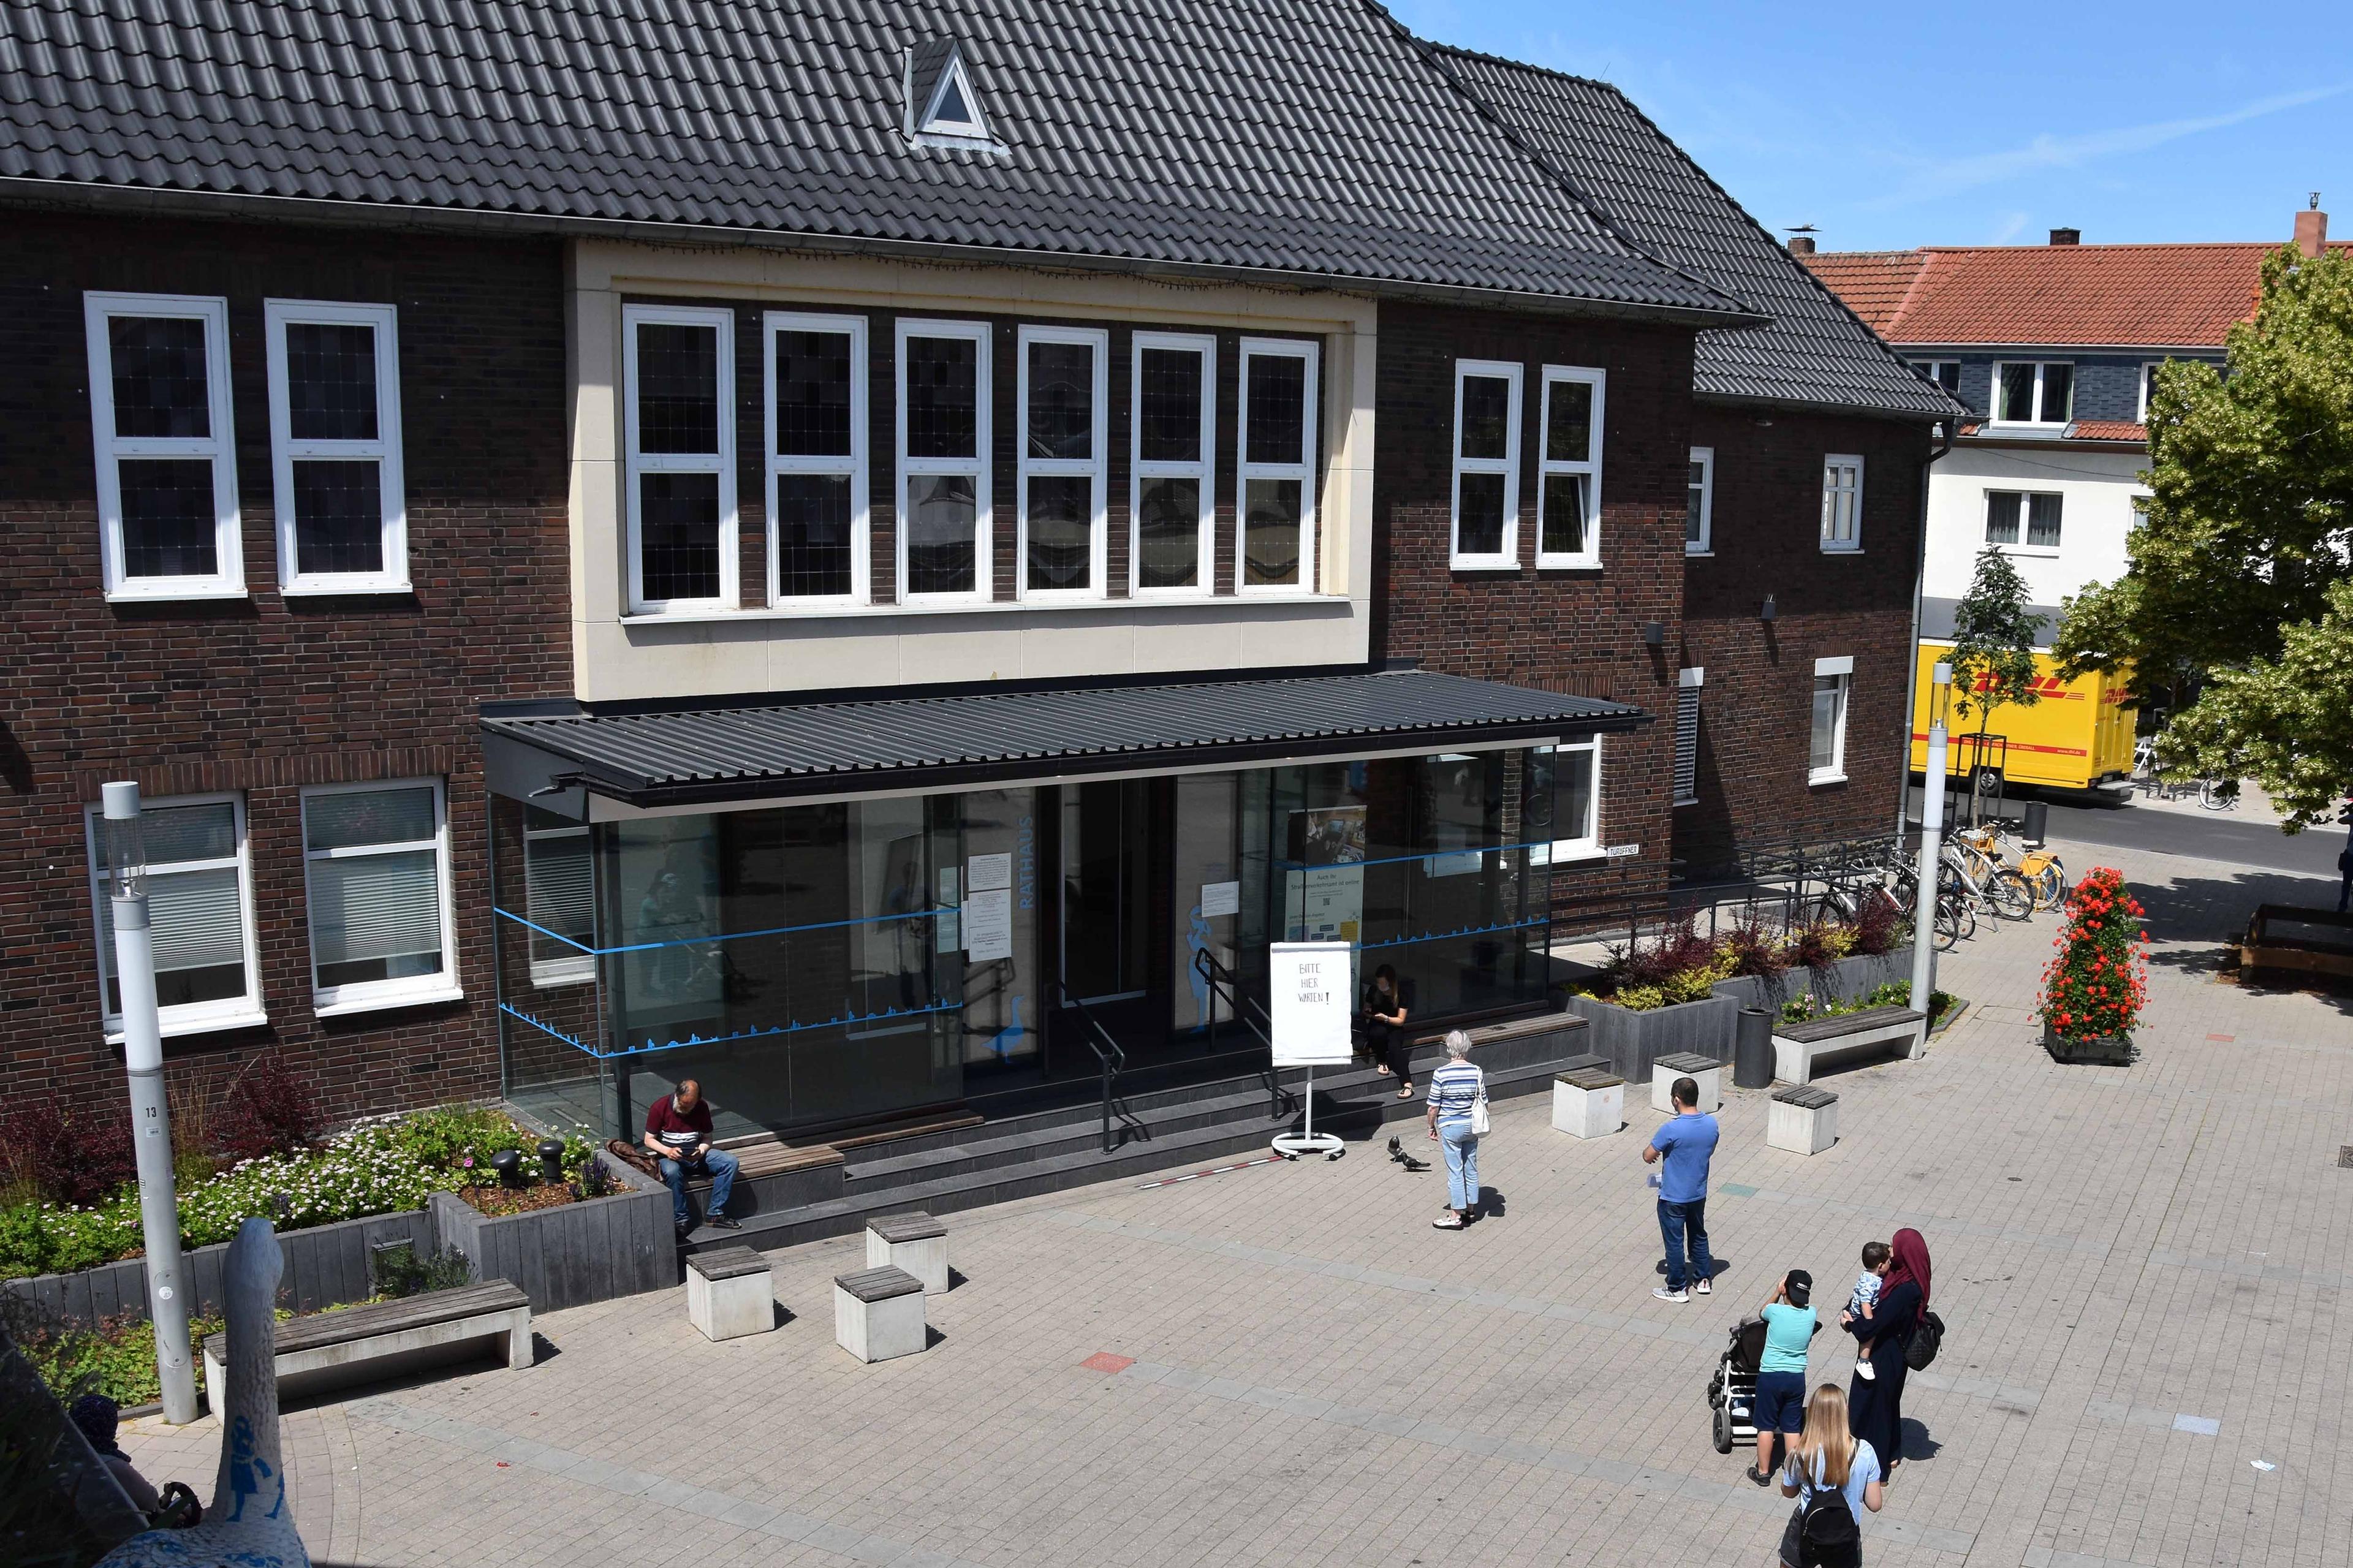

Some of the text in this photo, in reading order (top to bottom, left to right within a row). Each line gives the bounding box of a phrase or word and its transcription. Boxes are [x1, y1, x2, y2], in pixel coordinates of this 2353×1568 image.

[2105, 687, 2131, 704] DH
[1019, 816, 1034, 909] RATHAUS
[1299, 963, 1321, 974] BITTE
[1301, 977, 1318, 988] HIER
[146, 1107, 156, 1118] 13
